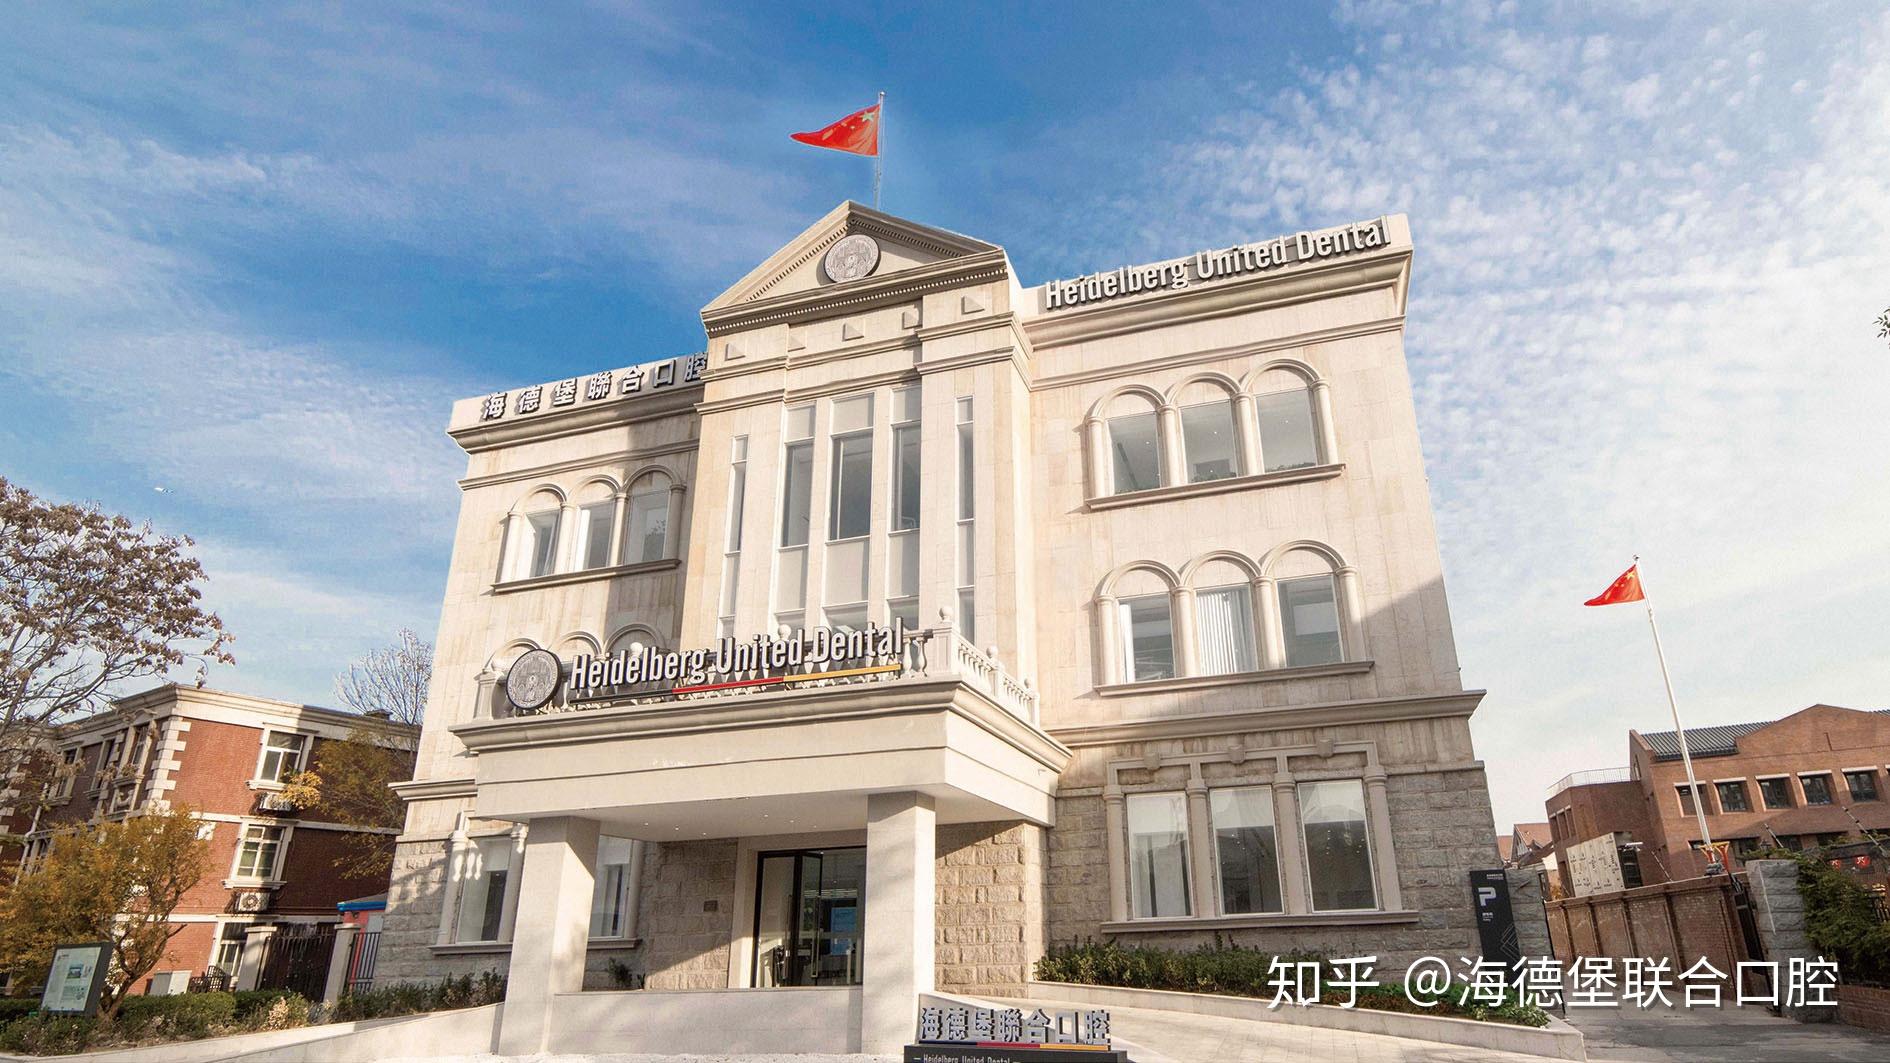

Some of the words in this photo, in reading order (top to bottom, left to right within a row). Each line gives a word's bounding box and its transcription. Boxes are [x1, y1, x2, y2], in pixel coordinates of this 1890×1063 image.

[1044, 259, 1191, 309] Heidelberg
[1196, 235, 1289, 280] United
[1296, 215, 1392, 261] Dental
[481, 352, 708, 421] 海德堡聯合口腔
[569, 646, 706, 692] Heidelberg
[716, 629, 804, 674] United
[812, 616, 903, 664] Dental
[1478, 887, 1497, 907] P
[920, 1007, 1112, 1045] 海德堡聯合口腔
